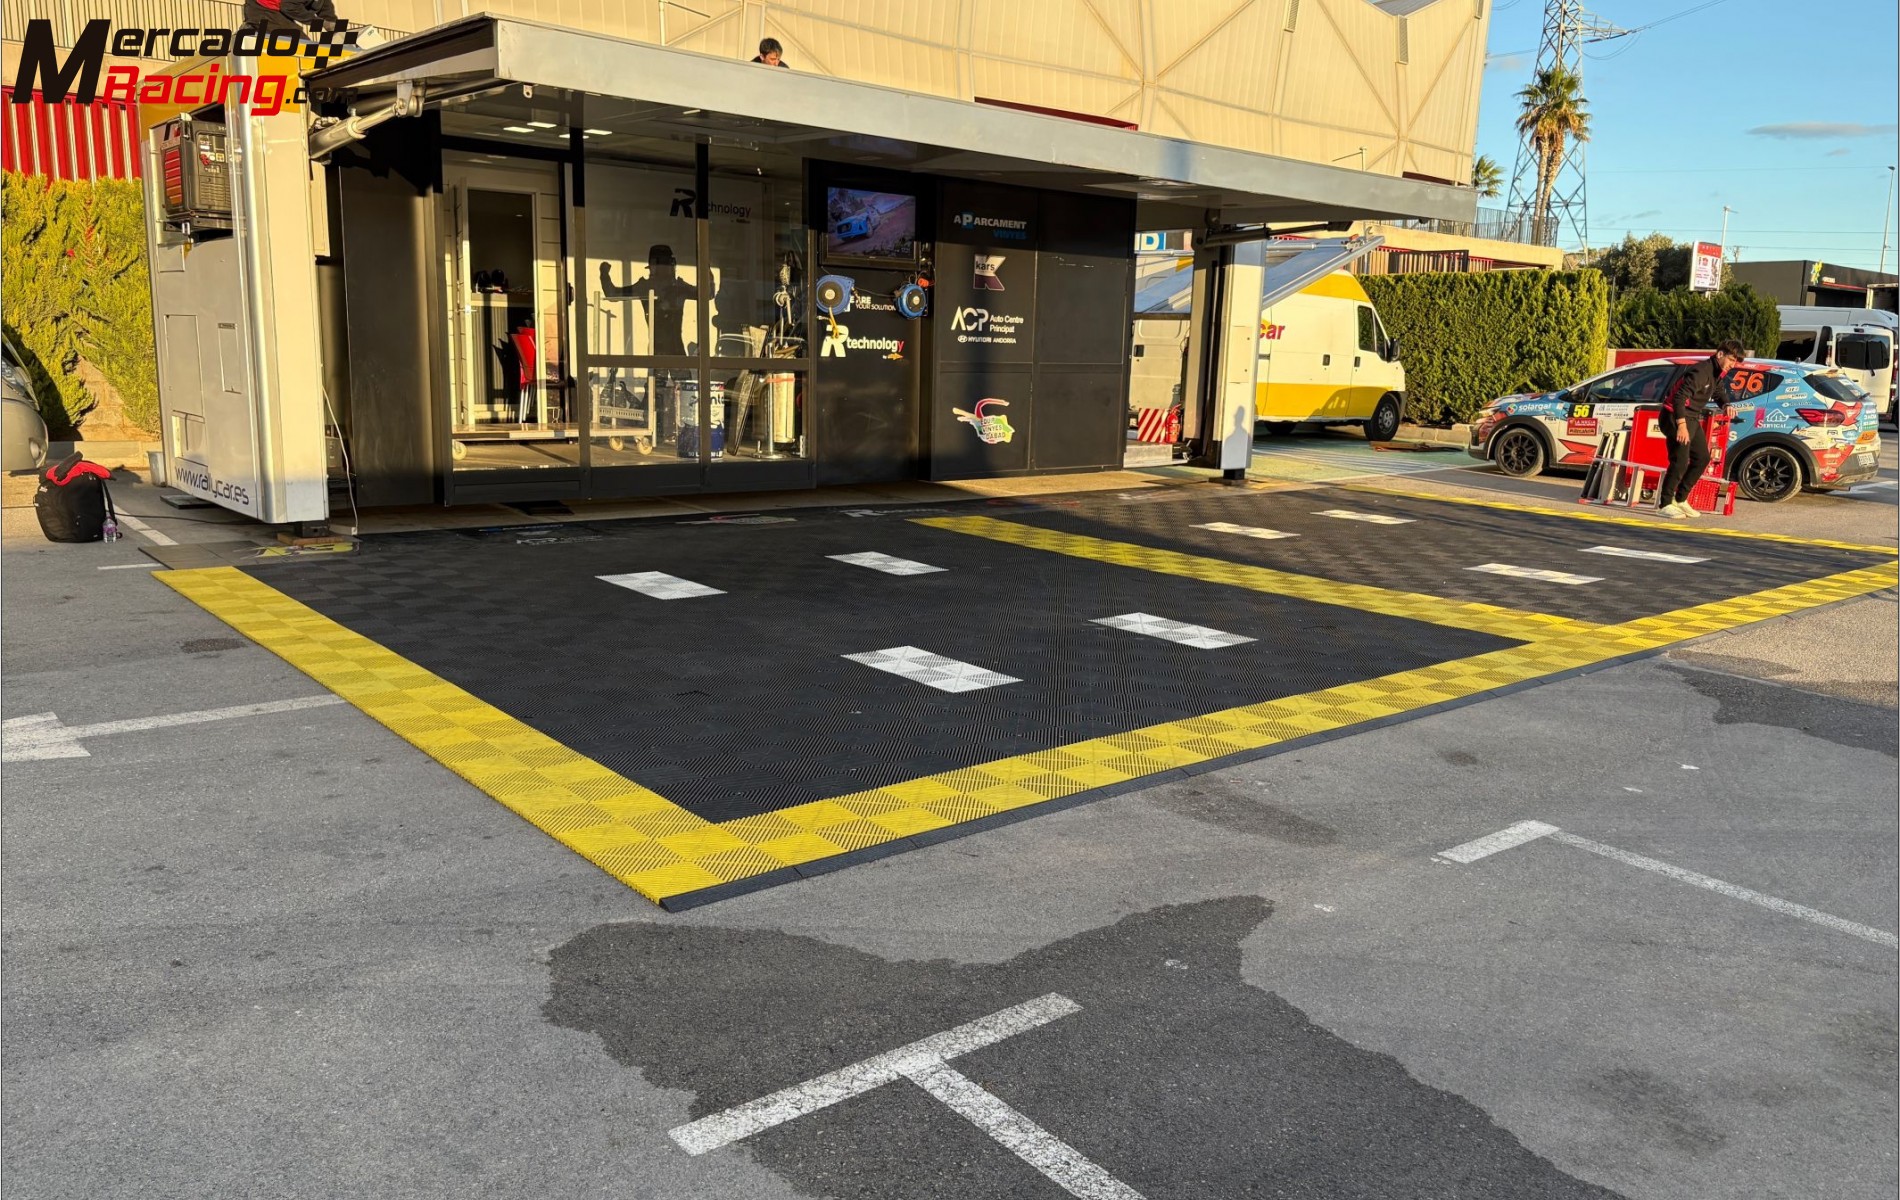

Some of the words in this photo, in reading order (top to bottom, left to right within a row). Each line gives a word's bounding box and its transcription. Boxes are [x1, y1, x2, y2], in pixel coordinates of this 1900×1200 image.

[975, 260, 995, 271] kars
[951, 306, 989, 332] ACP
[990, 314, 1004, 324] Auto
[1004, 315, 1024, 324] Centre
[989, 324, 1015, 334] Principal
[1729, 370, 1765, 394] 56
[1573, 403, 1590, 418] 56
[174, 465, 250, 505] www.rallycar.es
